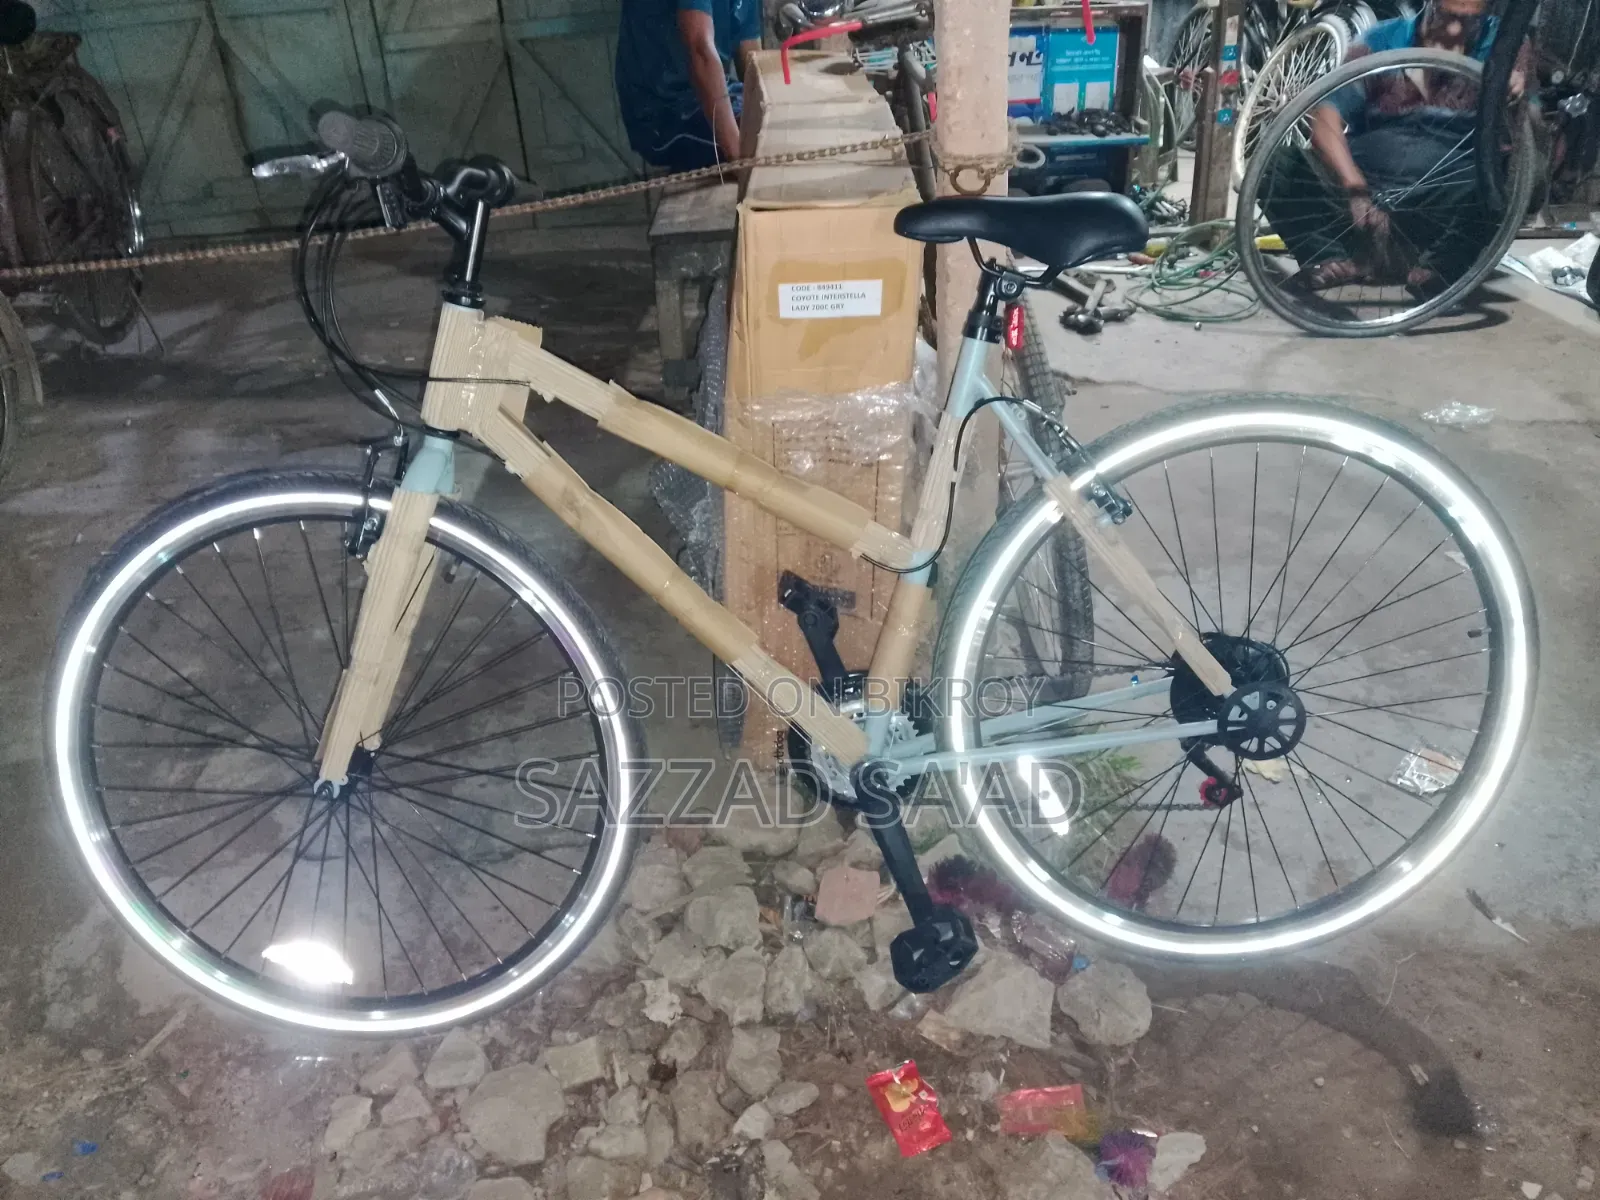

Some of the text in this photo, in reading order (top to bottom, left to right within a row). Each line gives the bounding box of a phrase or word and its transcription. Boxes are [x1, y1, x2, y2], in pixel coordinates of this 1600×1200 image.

[791, 292, 866, 302] COYOTE INTERSTELLA
[791, 304, 810, 312] LADY
